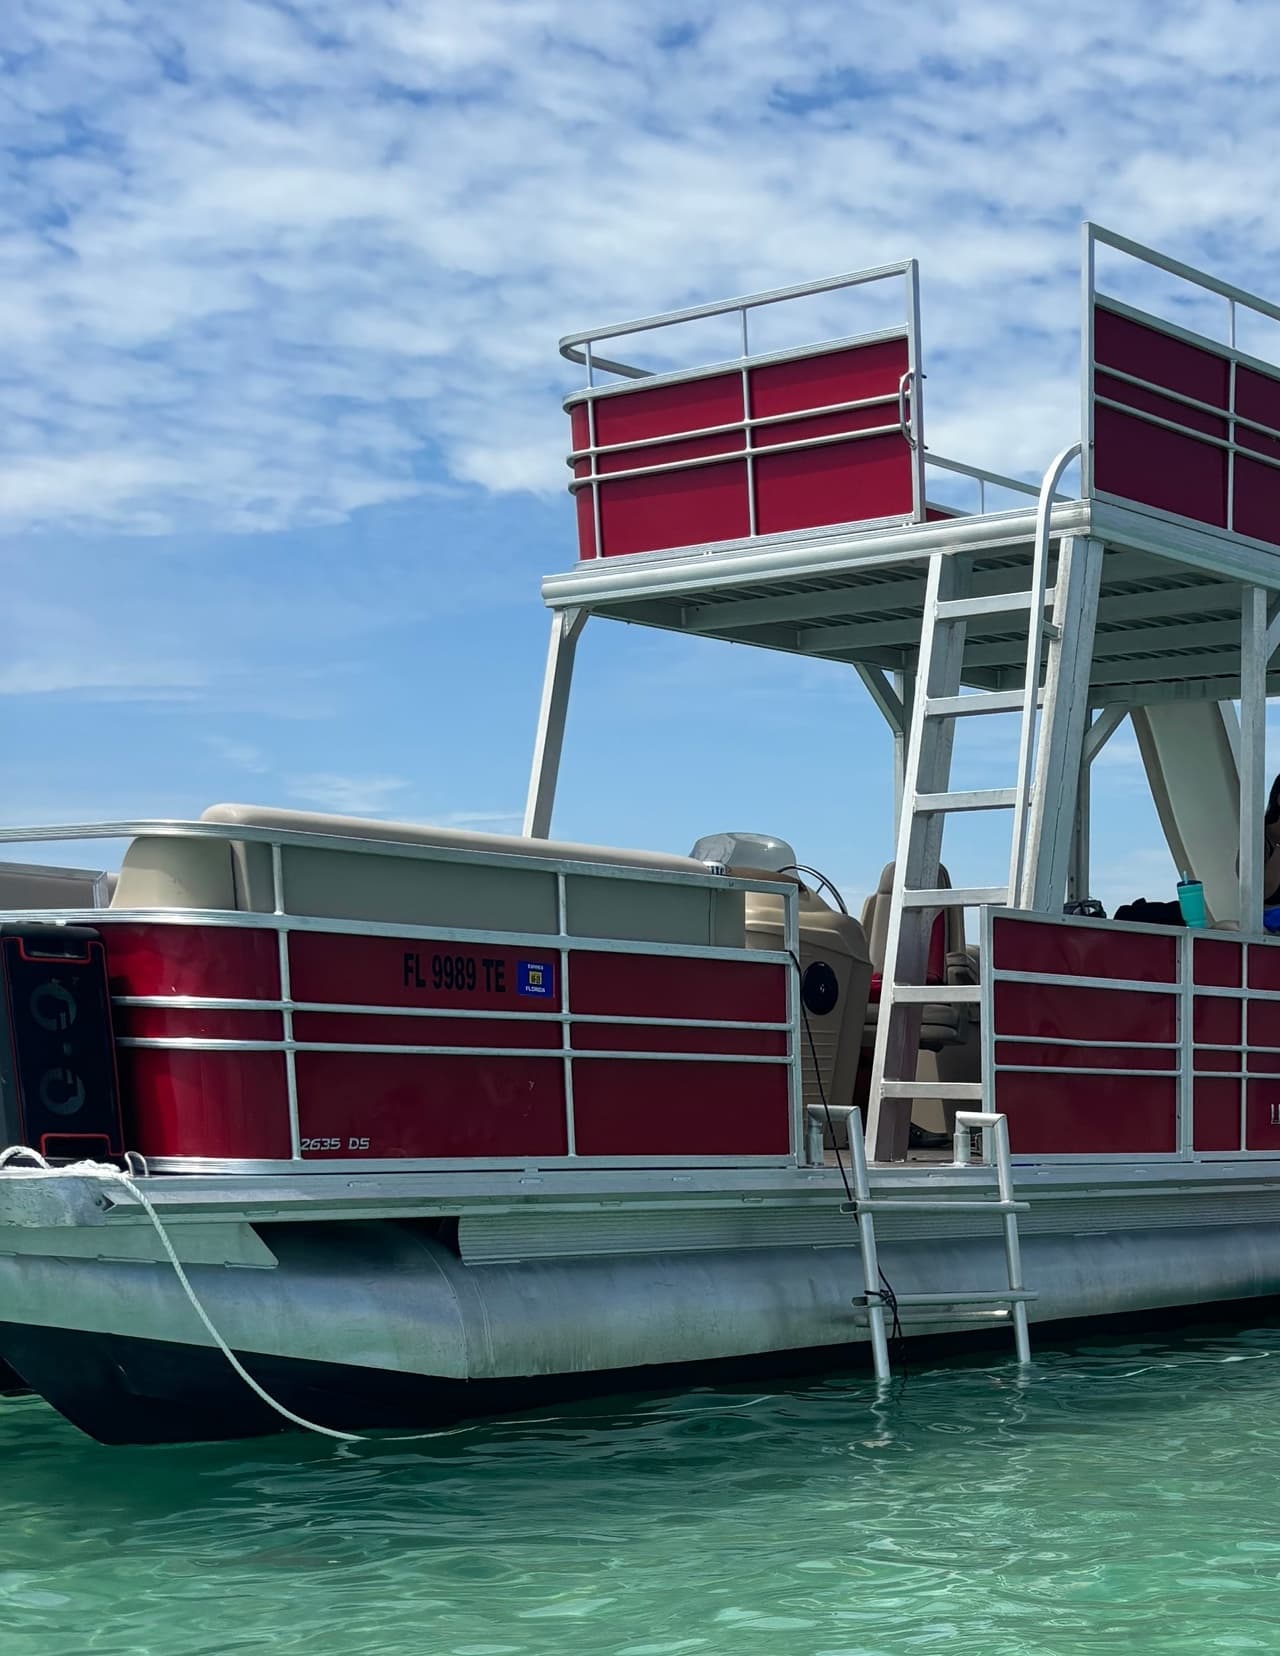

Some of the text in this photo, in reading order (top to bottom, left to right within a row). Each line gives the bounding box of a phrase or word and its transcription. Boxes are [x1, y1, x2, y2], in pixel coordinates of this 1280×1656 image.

[403, 953, 506, 993] FL 9989 TE
[301, 1137, 370, 1151] 2635 DS
